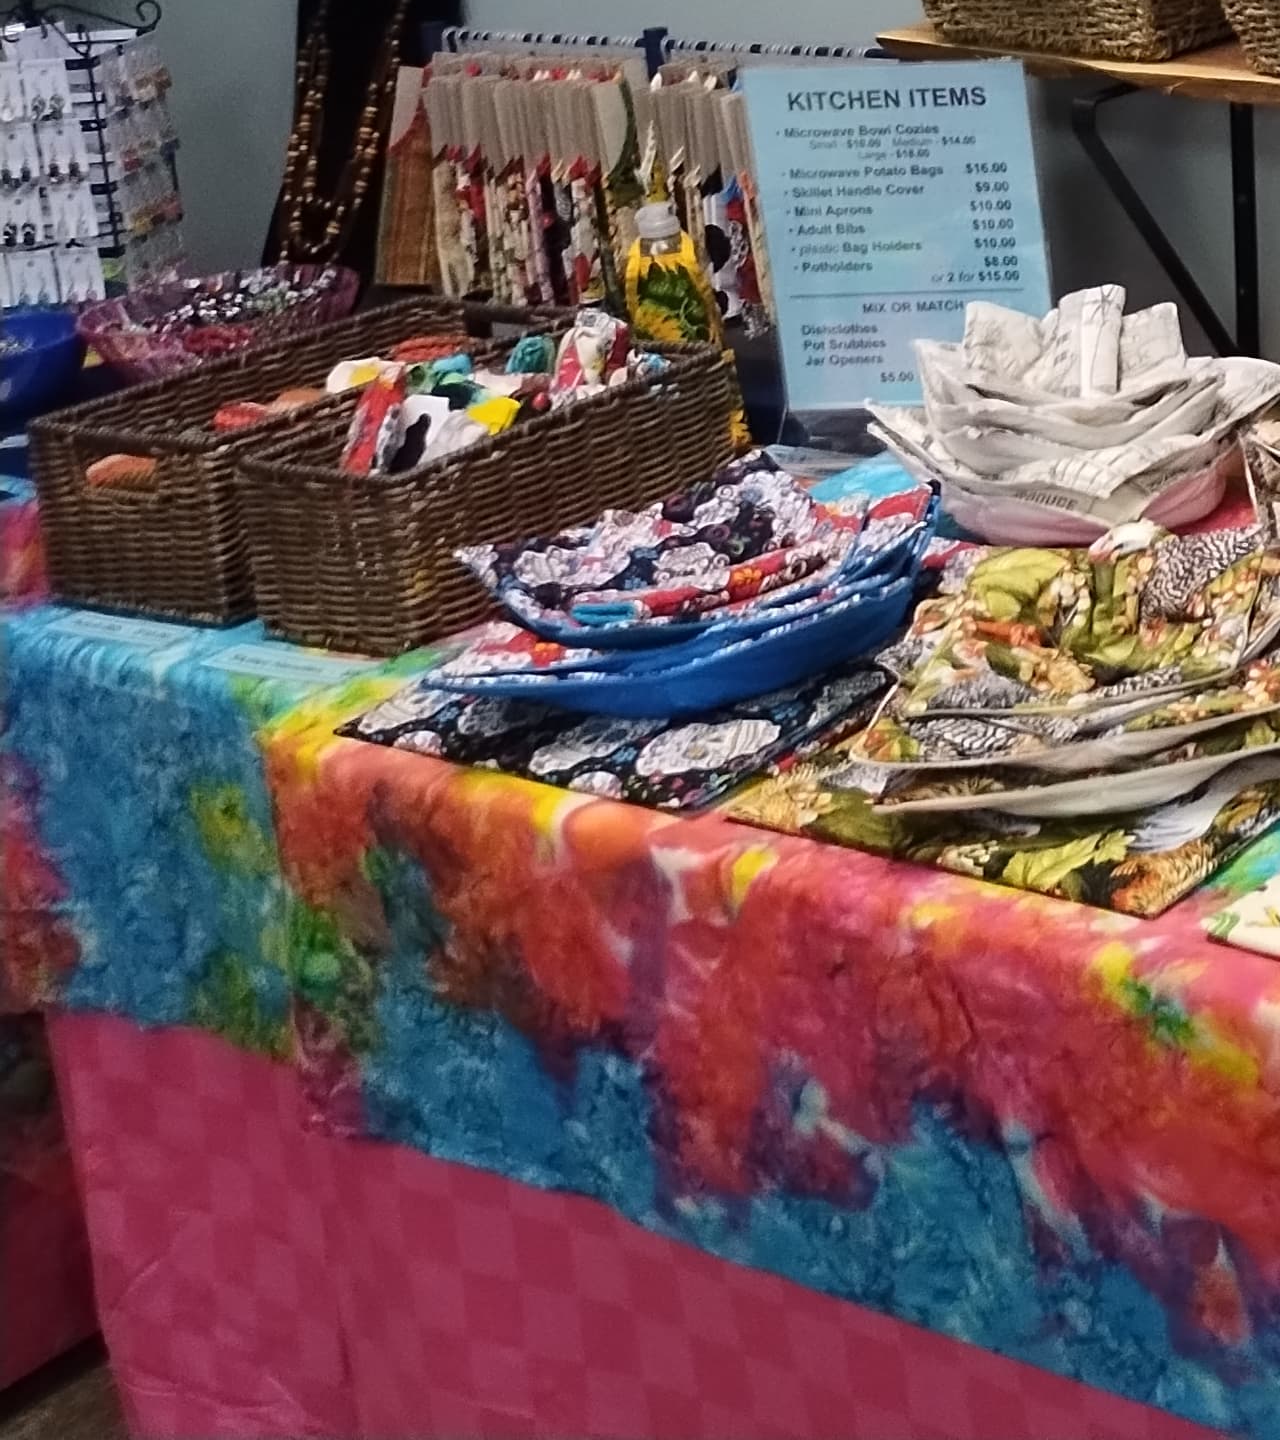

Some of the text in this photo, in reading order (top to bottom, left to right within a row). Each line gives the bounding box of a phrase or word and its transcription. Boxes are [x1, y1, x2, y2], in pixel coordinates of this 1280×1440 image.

[787, 87, 987, 112] KITCHEN ITEMS
[784, 123, 940, 139] Microwave Bowl Cozies
[789, 167, 859, 180] Microwave
[864, 165, 906, 178] Potato
[910, 164, 944, 179] Bags
[791, 181, 1009, 199] Skillet Handle Cover $9.00
[794, 199, 1012, 219] Mini Aprons $10.00
[797, 224, 832, 236] Adult
[836, 222, 866, 235] Bibs
[842, 241, 869, 256] Bag
[872, 239, 923, 253] Holders
[802, 261, 873, 273] Potholders
[978, 269, 1020, 282] $15.00
[862, 300, 965, 314] MIX OR MATCH
[803, 339, 826, 351] Pot
[806, 354, 884, 368] Jar Openers
